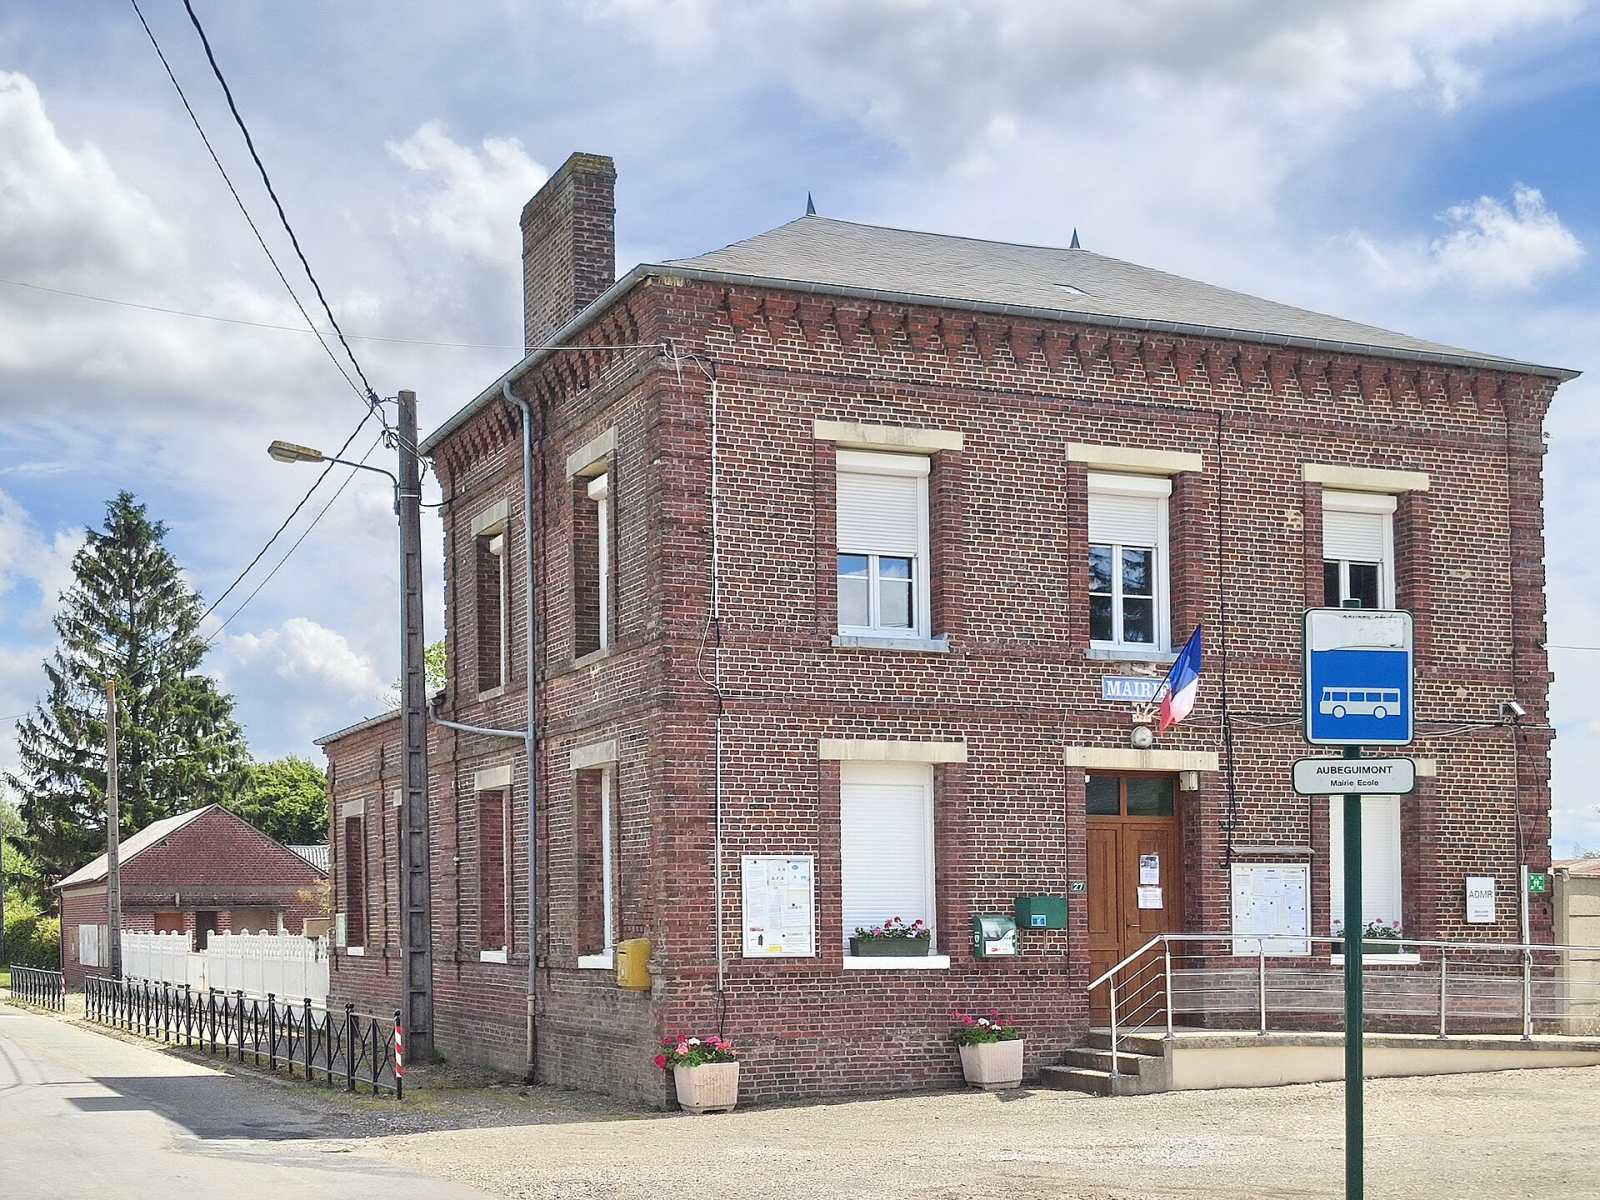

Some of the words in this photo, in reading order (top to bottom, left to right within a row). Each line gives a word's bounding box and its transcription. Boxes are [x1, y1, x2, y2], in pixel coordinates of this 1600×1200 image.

[1316, 765, 1393, 775] AUBEGUIMONT
[1357, 779, 1379, 787] Ecole
[1469, 889, 1493, 899] ADMR
